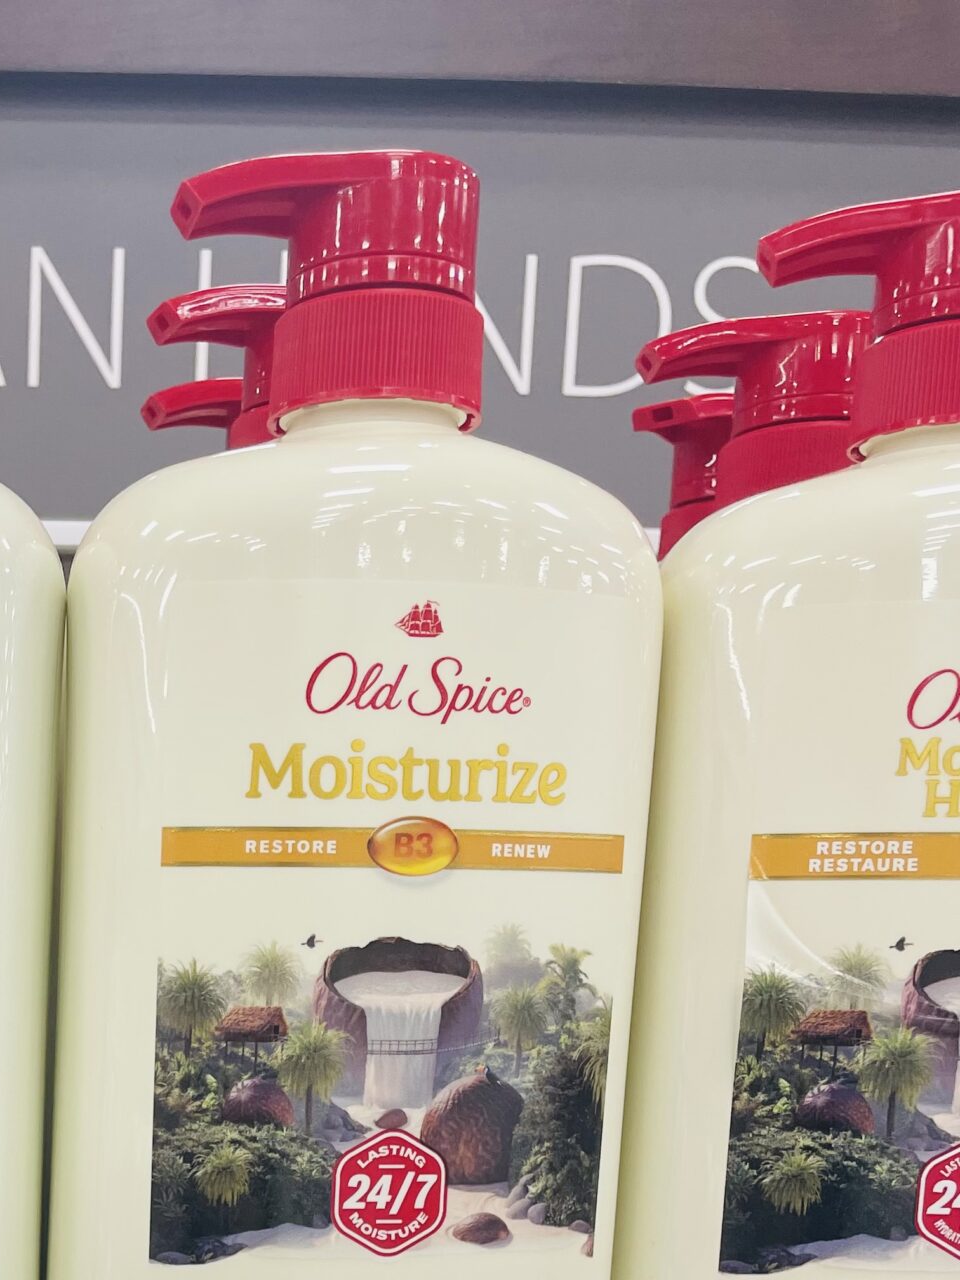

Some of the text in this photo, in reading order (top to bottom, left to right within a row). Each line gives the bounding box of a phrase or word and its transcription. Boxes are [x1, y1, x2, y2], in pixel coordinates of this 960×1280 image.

[193, 247, 759, 396] NDS
[305, 651, 409, 715] Old
[244, 738, 568, 806] Moisturize
[245, 831, 552, 860] RESTORE B3 RENEW
[816, 840, 913, 855] RESTORE
[808, 857, 918, 873] RESTAURE
[356, 1144, 427, 1169] LASTING
[342, 1171, 438, 1216] 24/7
[348, 1211, 429, 1241] MOISTURE
